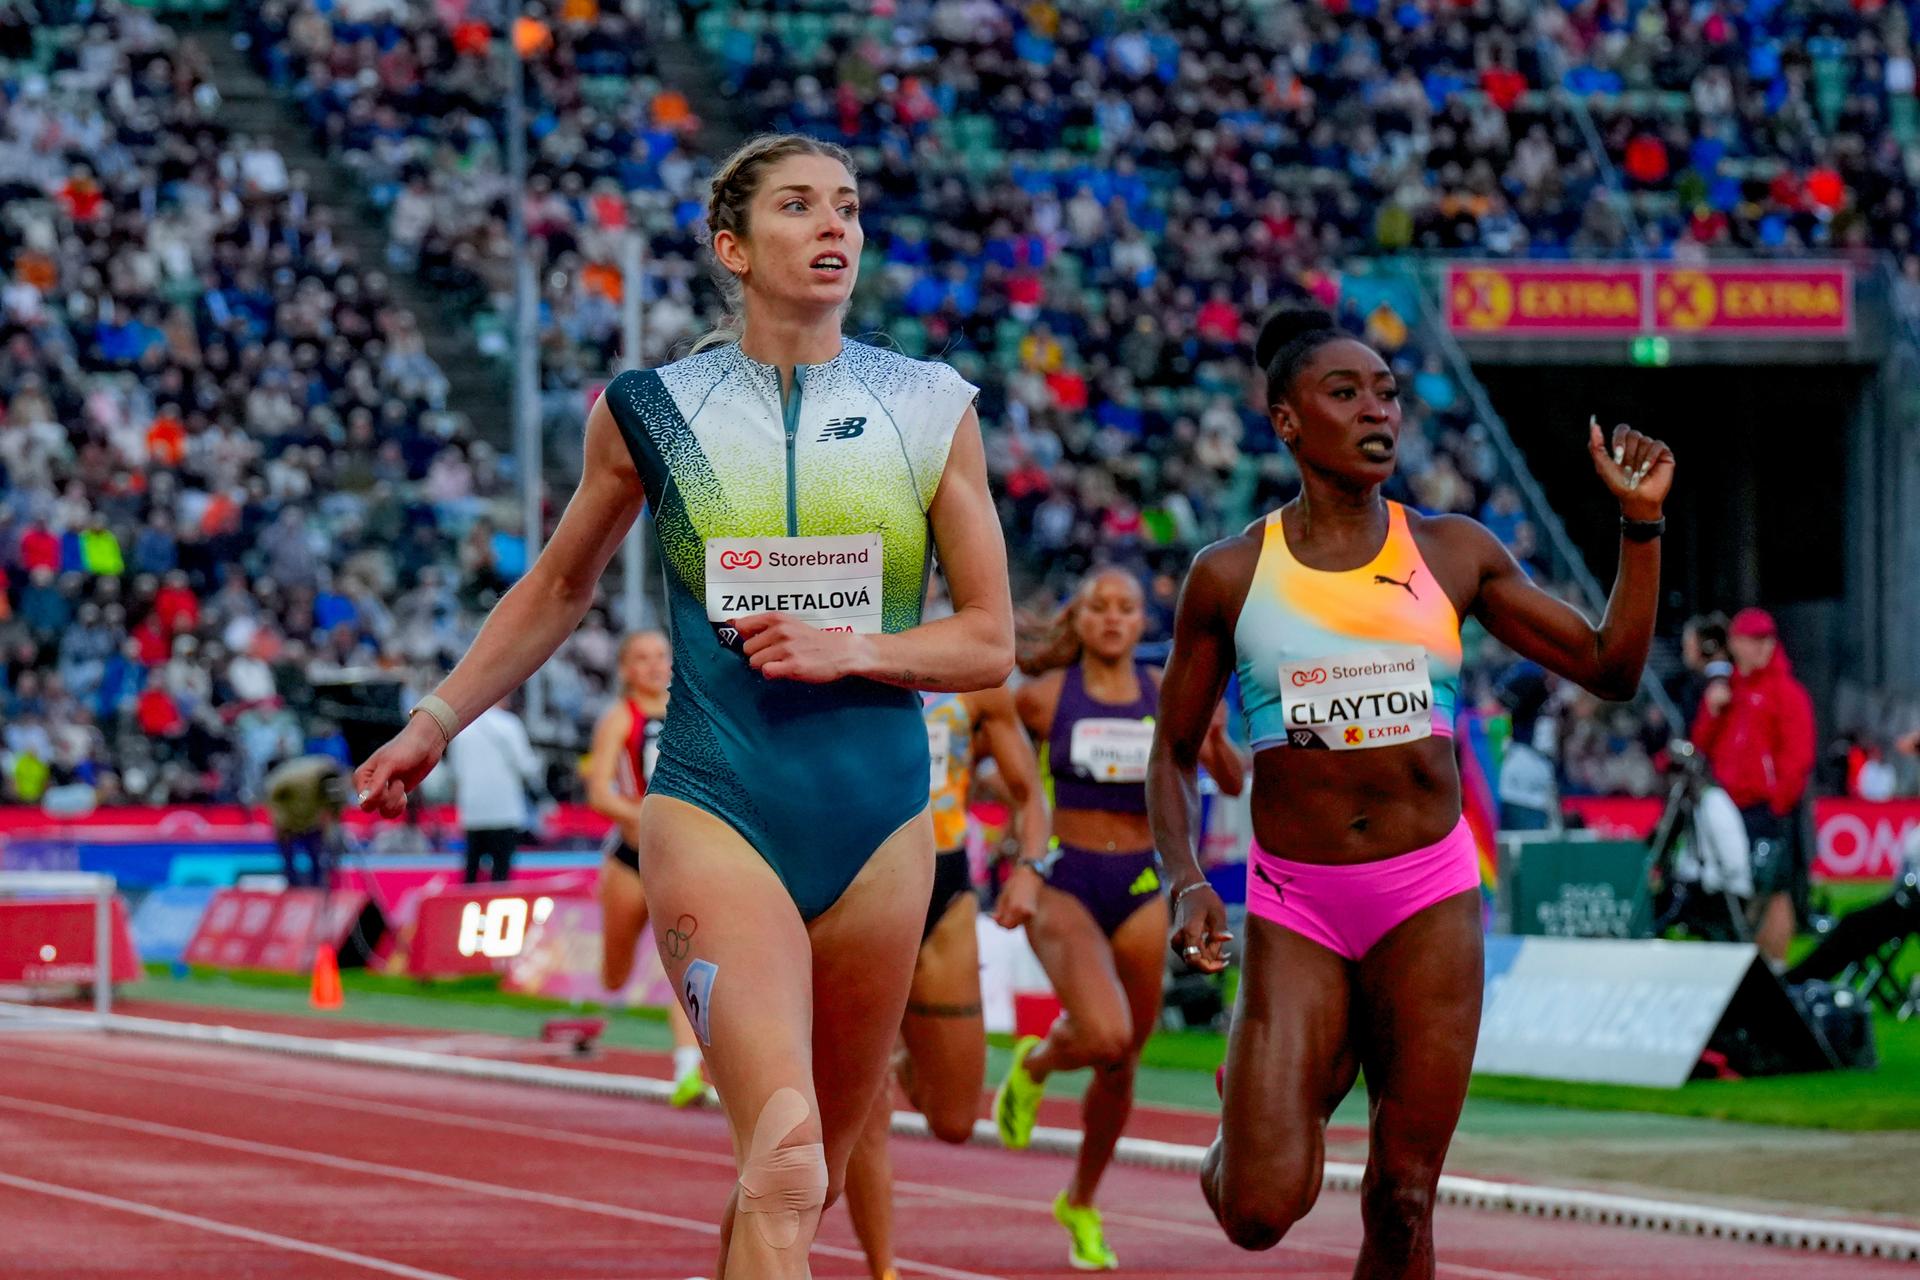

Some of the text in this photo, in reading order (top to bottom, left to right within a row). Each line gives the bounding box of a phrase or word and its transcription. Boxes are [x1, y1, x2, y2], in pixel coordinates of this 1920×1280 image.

[1518, 280, 1638, 319] EXTRA
[1722, 280, 1841, 319] EXTRA
[768, 548, 869, 567] Storebrand
[721, 586, 871, 612] ZAPLETALOVÁ
[1332, 658, 1415, 680] Storebrand
[1290, 689, 1429, 725] CLAYTON
[1368, 724, 1410, 739] EXTRA
